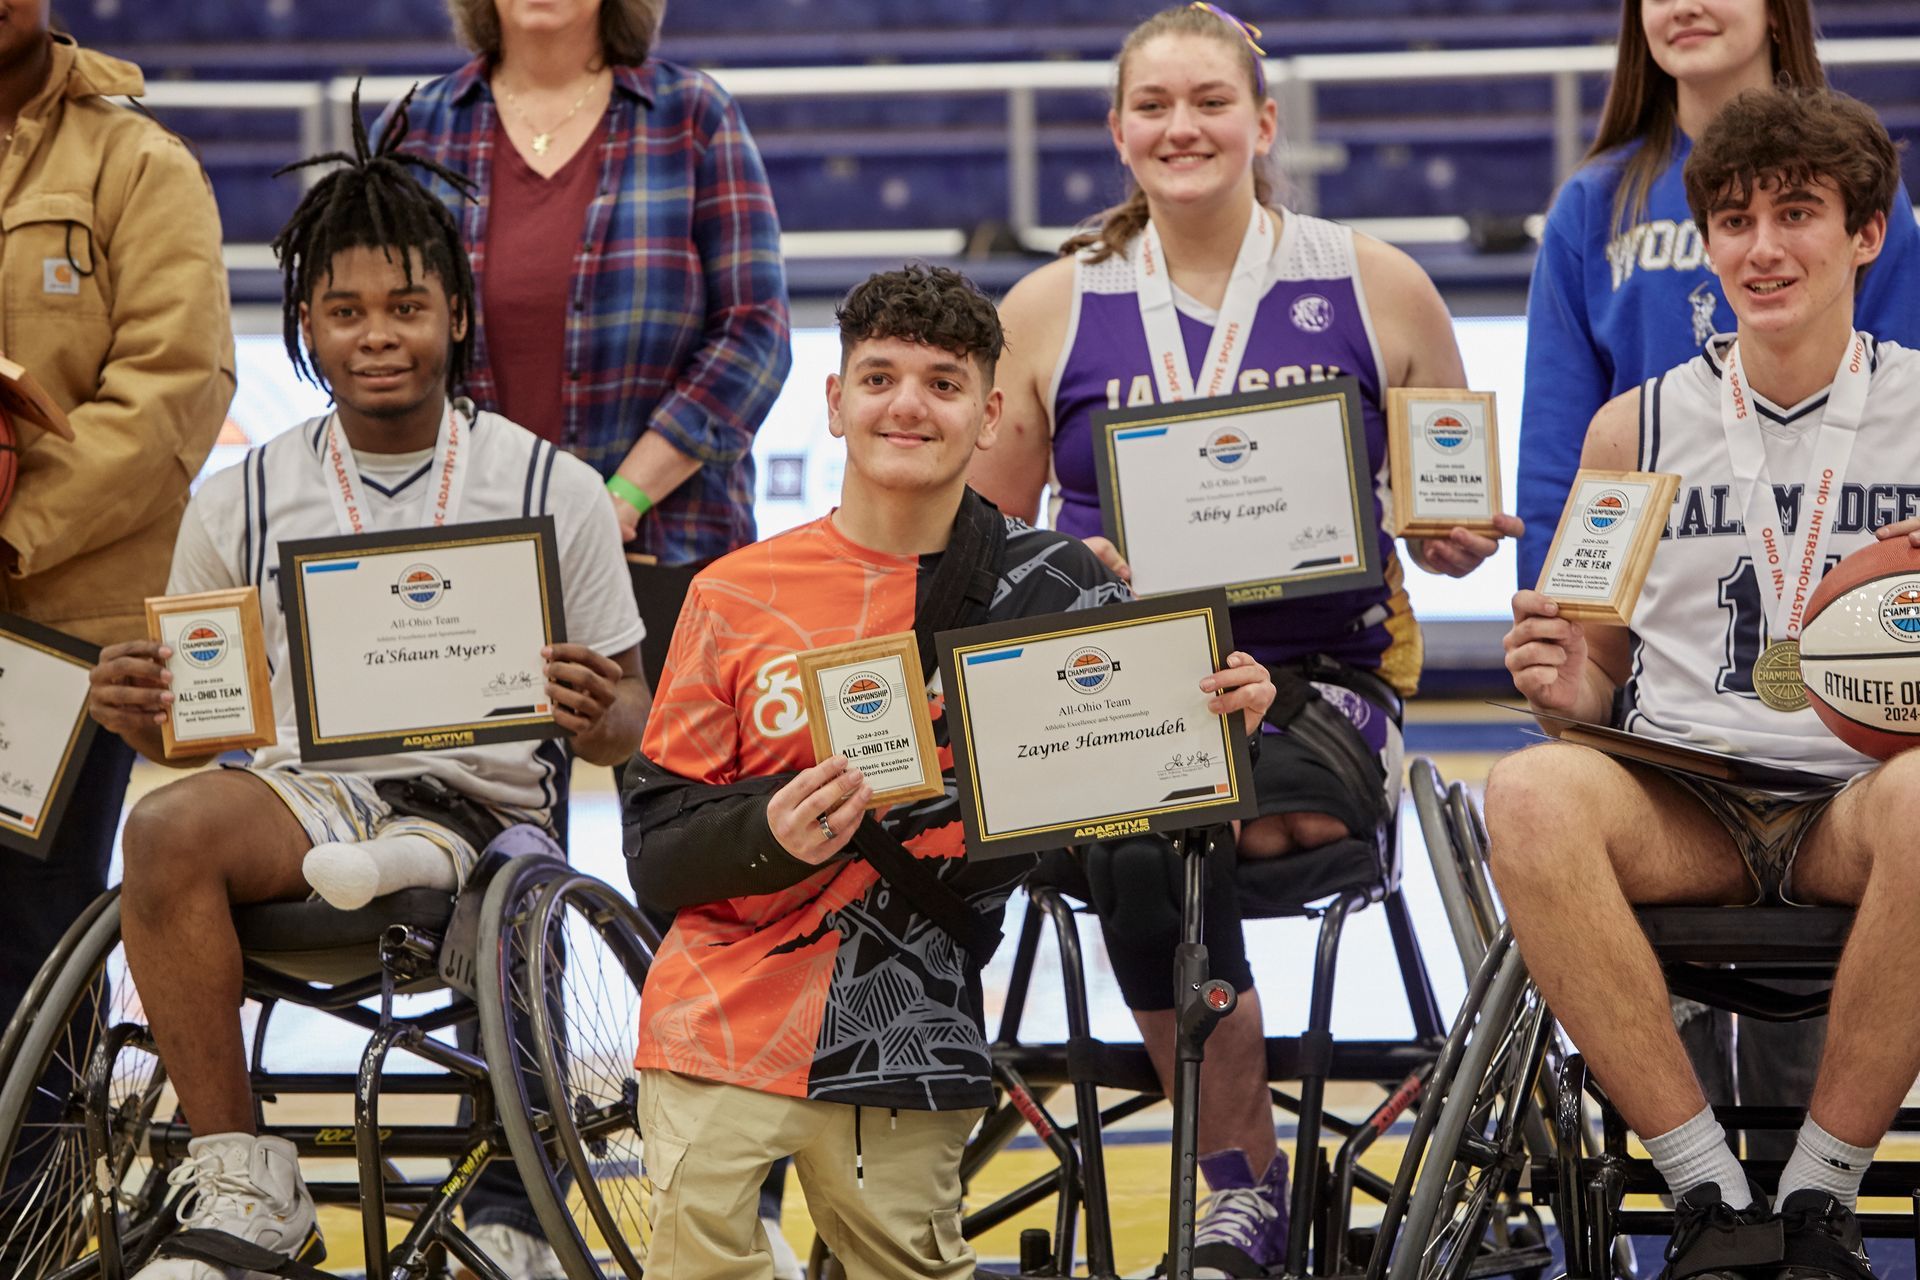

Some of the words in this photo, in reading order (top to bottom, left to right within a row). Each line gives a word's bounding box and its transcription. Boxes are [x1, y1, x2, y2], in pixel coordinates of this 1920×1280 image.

[1606, 219, 1713, 293] WOO
[1218, 322, 1240, 364] SPORTS
[1850, 341, 1863, 374] OHIO
[1729, 371, 1747, 420] SPORTS
[436, 449, 456, 510] ADAPTIVE
[1420, 474, 1458, 484] ALL-OHIO
[1459, 474, 1482, 484] TEAM
[1816, 467, 1834, 506] OHIO
[1188, 504, 1231, 525] Abby
[1236, 497, 1287, 520] Lapole
[1574, 548, 1608, 559] ATHLETE
[1761, 527, 1780, 565] OHIO
[1562, 558, 1572, 568] OF
[1574, 559, 1589, 569] THE
[1591, 560, 1612, 570] YEAR
[1787, 509, 1824, 632] INTERSCHOLASTIC
[390, 616, 432, 630] All-Ohio
[433, 615, 460, 626] Team
[182, 639, 225, 651] CHAMPIONSHIP
[363, 646, 440, 666] Ta'Shaun
[443, 642, 497, 665] Myers
[1067, 663, 1110, 677] CHAMPIONSHIP
[178, 690, 217, 703] ALL-OHIO
[219, 687, 243, 699] TEAM
[842, 688, 889, 705] CHAMPIONSHIP
[1824, 670, 1895, 706] ATHLETE
[1900, 680, 1920, 706] O
[1058, 701, 1102, 716] All-Ohio
[1103, 697, 1132, 709] Team
[1044, 723, 1066, 732] Athletic
[1067, 718, 1097, 729] Excellence
[1098, 715, 1108, 723] and
[1109, 709, 1150, 722] Sportsmanship
[402, 731, 474, 747] ADAPTIVE
[856, 729, 889, 741] 2024-2025
[1017, 738, 1070, 760] Zayne
[1075, 716, 1187, 750] Hammoudeh
[842, 742, 883, 759] ALL-OHIO
[883, 736, 910, 752] TEAM
[857, 763, 880, 772] thletic
[880, 756, 914, 768] Excellence
[863, 763, 910, 778] Sportsmanship
[1074, 817, 1150, 838] ADAPTIVE
[1096, 829, 1130, 839] SPORTS
[1130, 825, 1150, 833] OHIO
